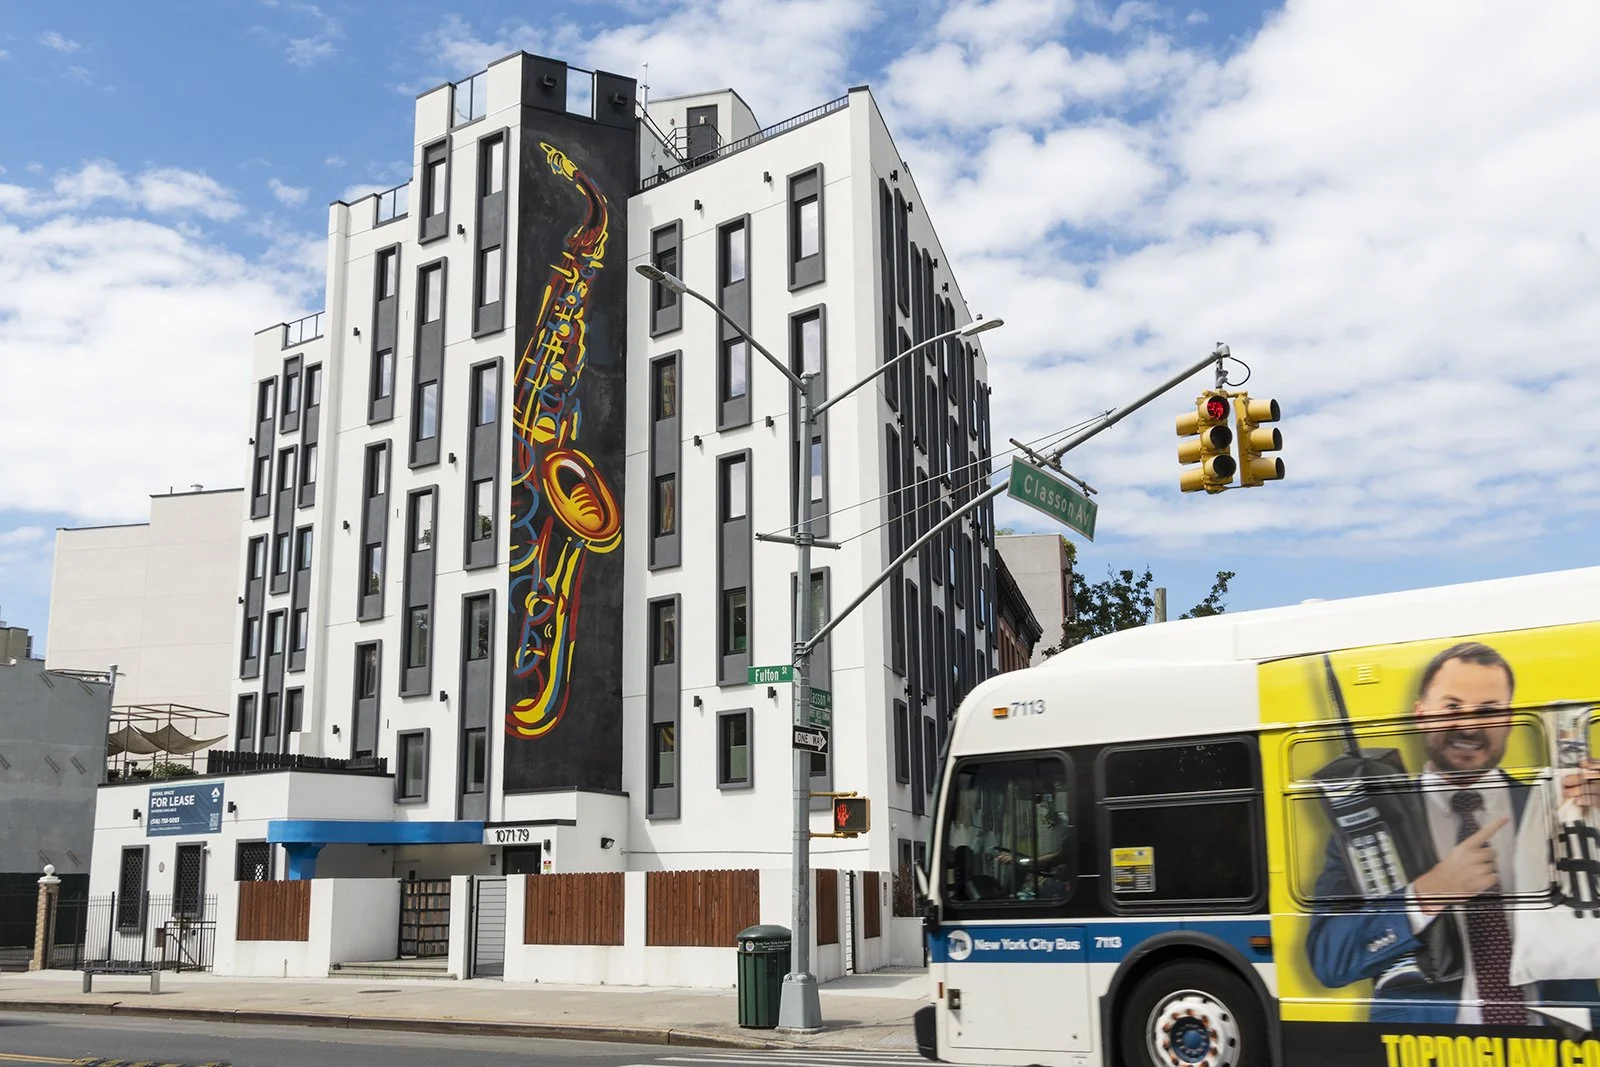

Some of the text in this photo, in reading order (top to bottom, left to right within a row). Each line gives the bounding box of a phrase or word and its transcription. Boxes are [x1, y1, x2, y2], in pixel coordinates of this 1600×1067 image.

[1024, 474, 1090, 526] Classon Av
[755, 666, 788, 682] Fulton St
[810, 688, 827, 705] lasson
[1011, 699, 1046, 717] 7113
[797, 733, 824, 746] ONE WAY
[151, 795, 195, 808] FOR LEASE
[974, 938, 1081, 953] New York City Bus
[1093, 936, 1123, 949] 7113
